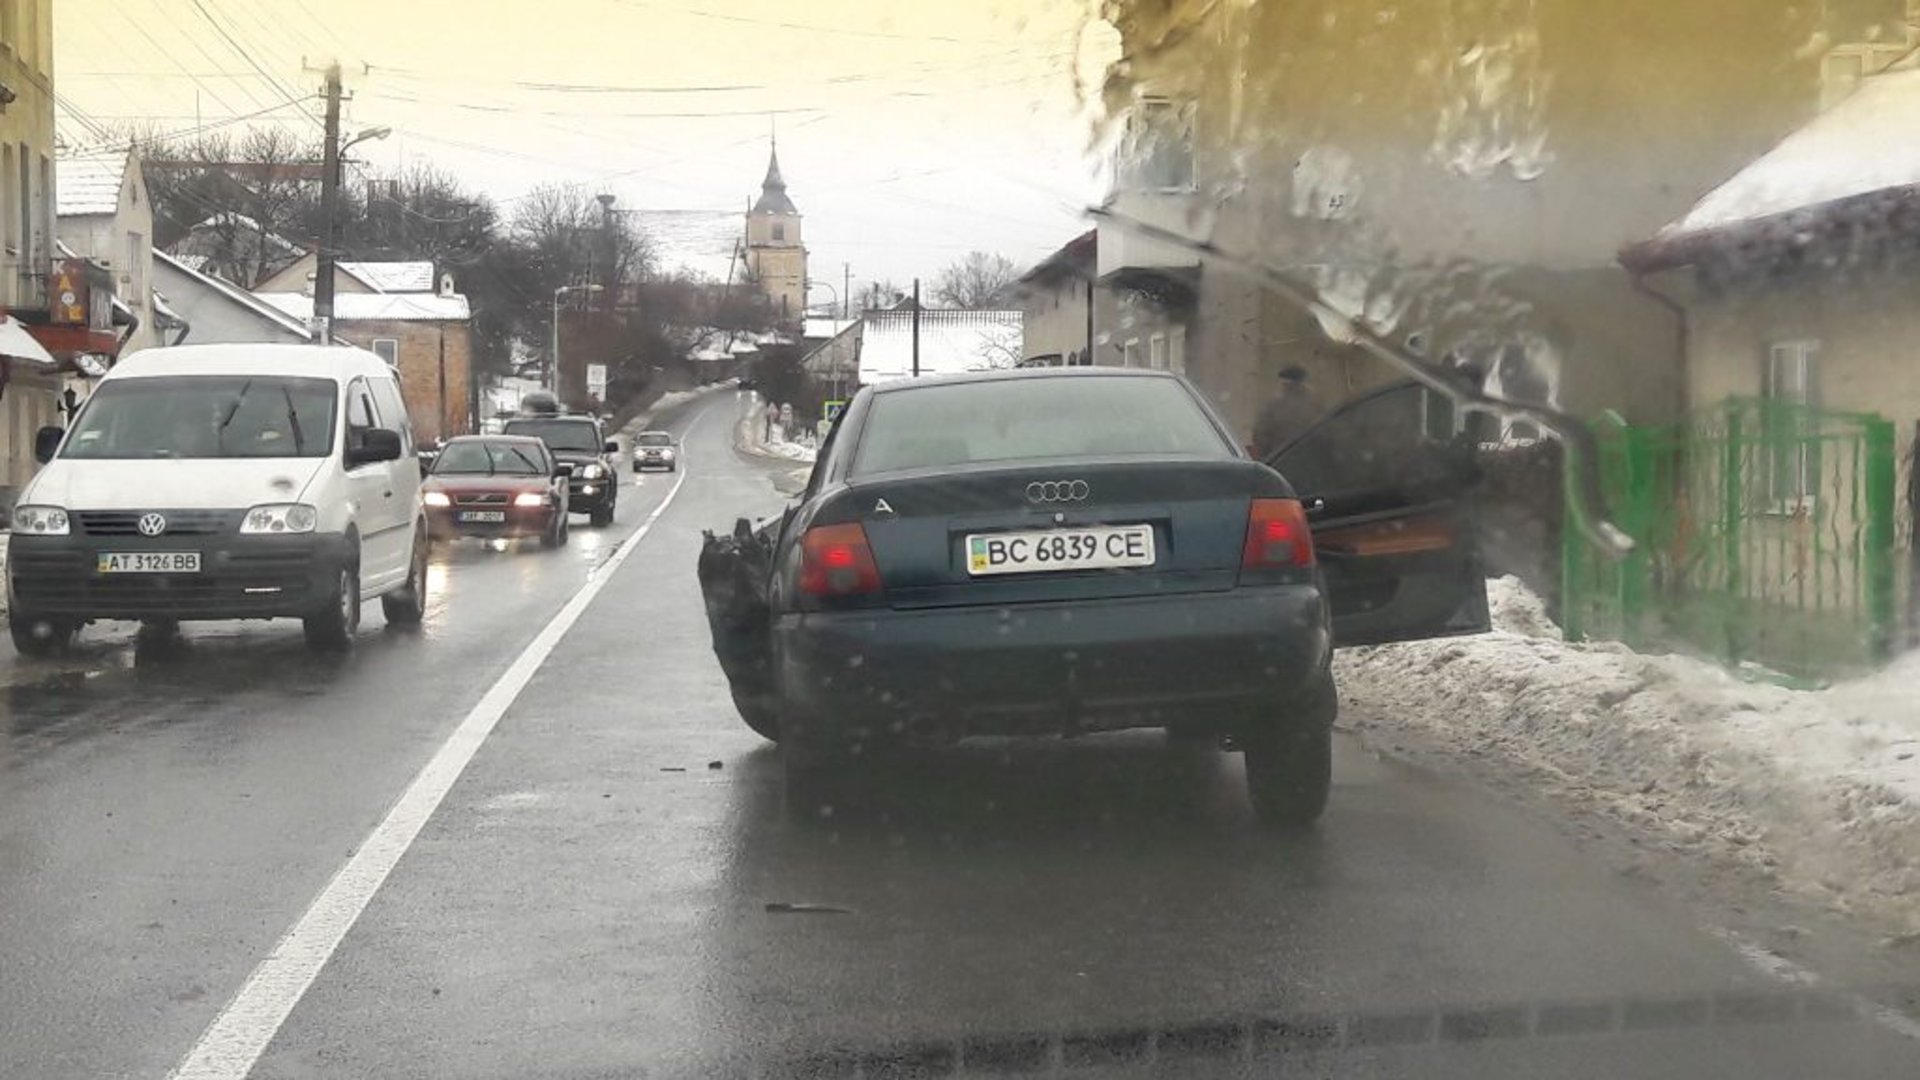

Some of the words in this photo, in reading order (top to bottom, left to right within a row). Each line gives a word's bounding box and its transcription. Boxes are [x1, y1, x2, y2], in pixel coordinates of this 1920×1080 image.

[988, 539, 1028, 565] BC
[1036, 535, 1098, 561] 6839
[1106, 532, 1145, 558] CE
[111, 555, 131, 570] AT
[135, 554, 170, 570] 3126
[173, 554, 197, 569] BB
